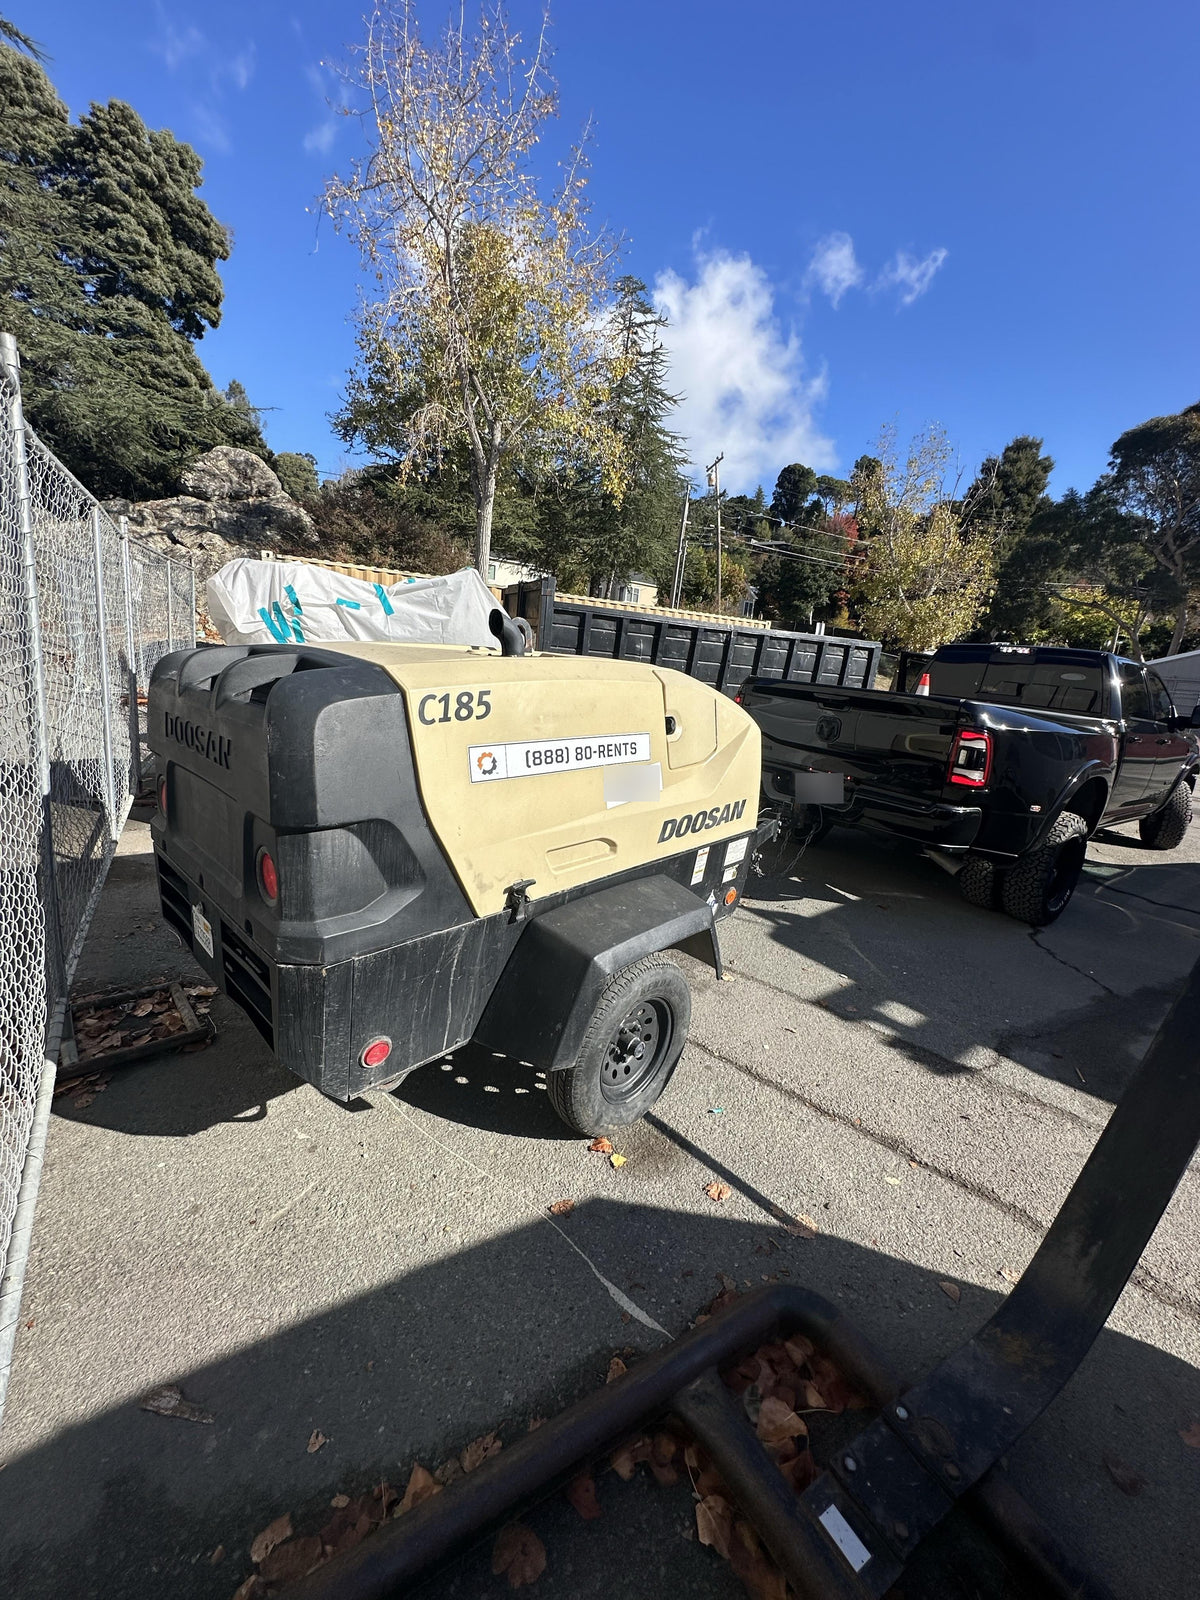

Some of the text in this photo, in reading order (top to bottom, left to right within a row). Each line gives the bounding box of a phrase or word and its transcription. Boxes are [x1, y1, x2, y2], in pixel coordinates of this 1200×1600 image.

[418, 690, 491, 725] C185
[165, 711, 231, 770] DOOSAN
[525, 741, 637, 768] (888) 80-RENTS
[657, 798, 747, 844] DOOSAN
